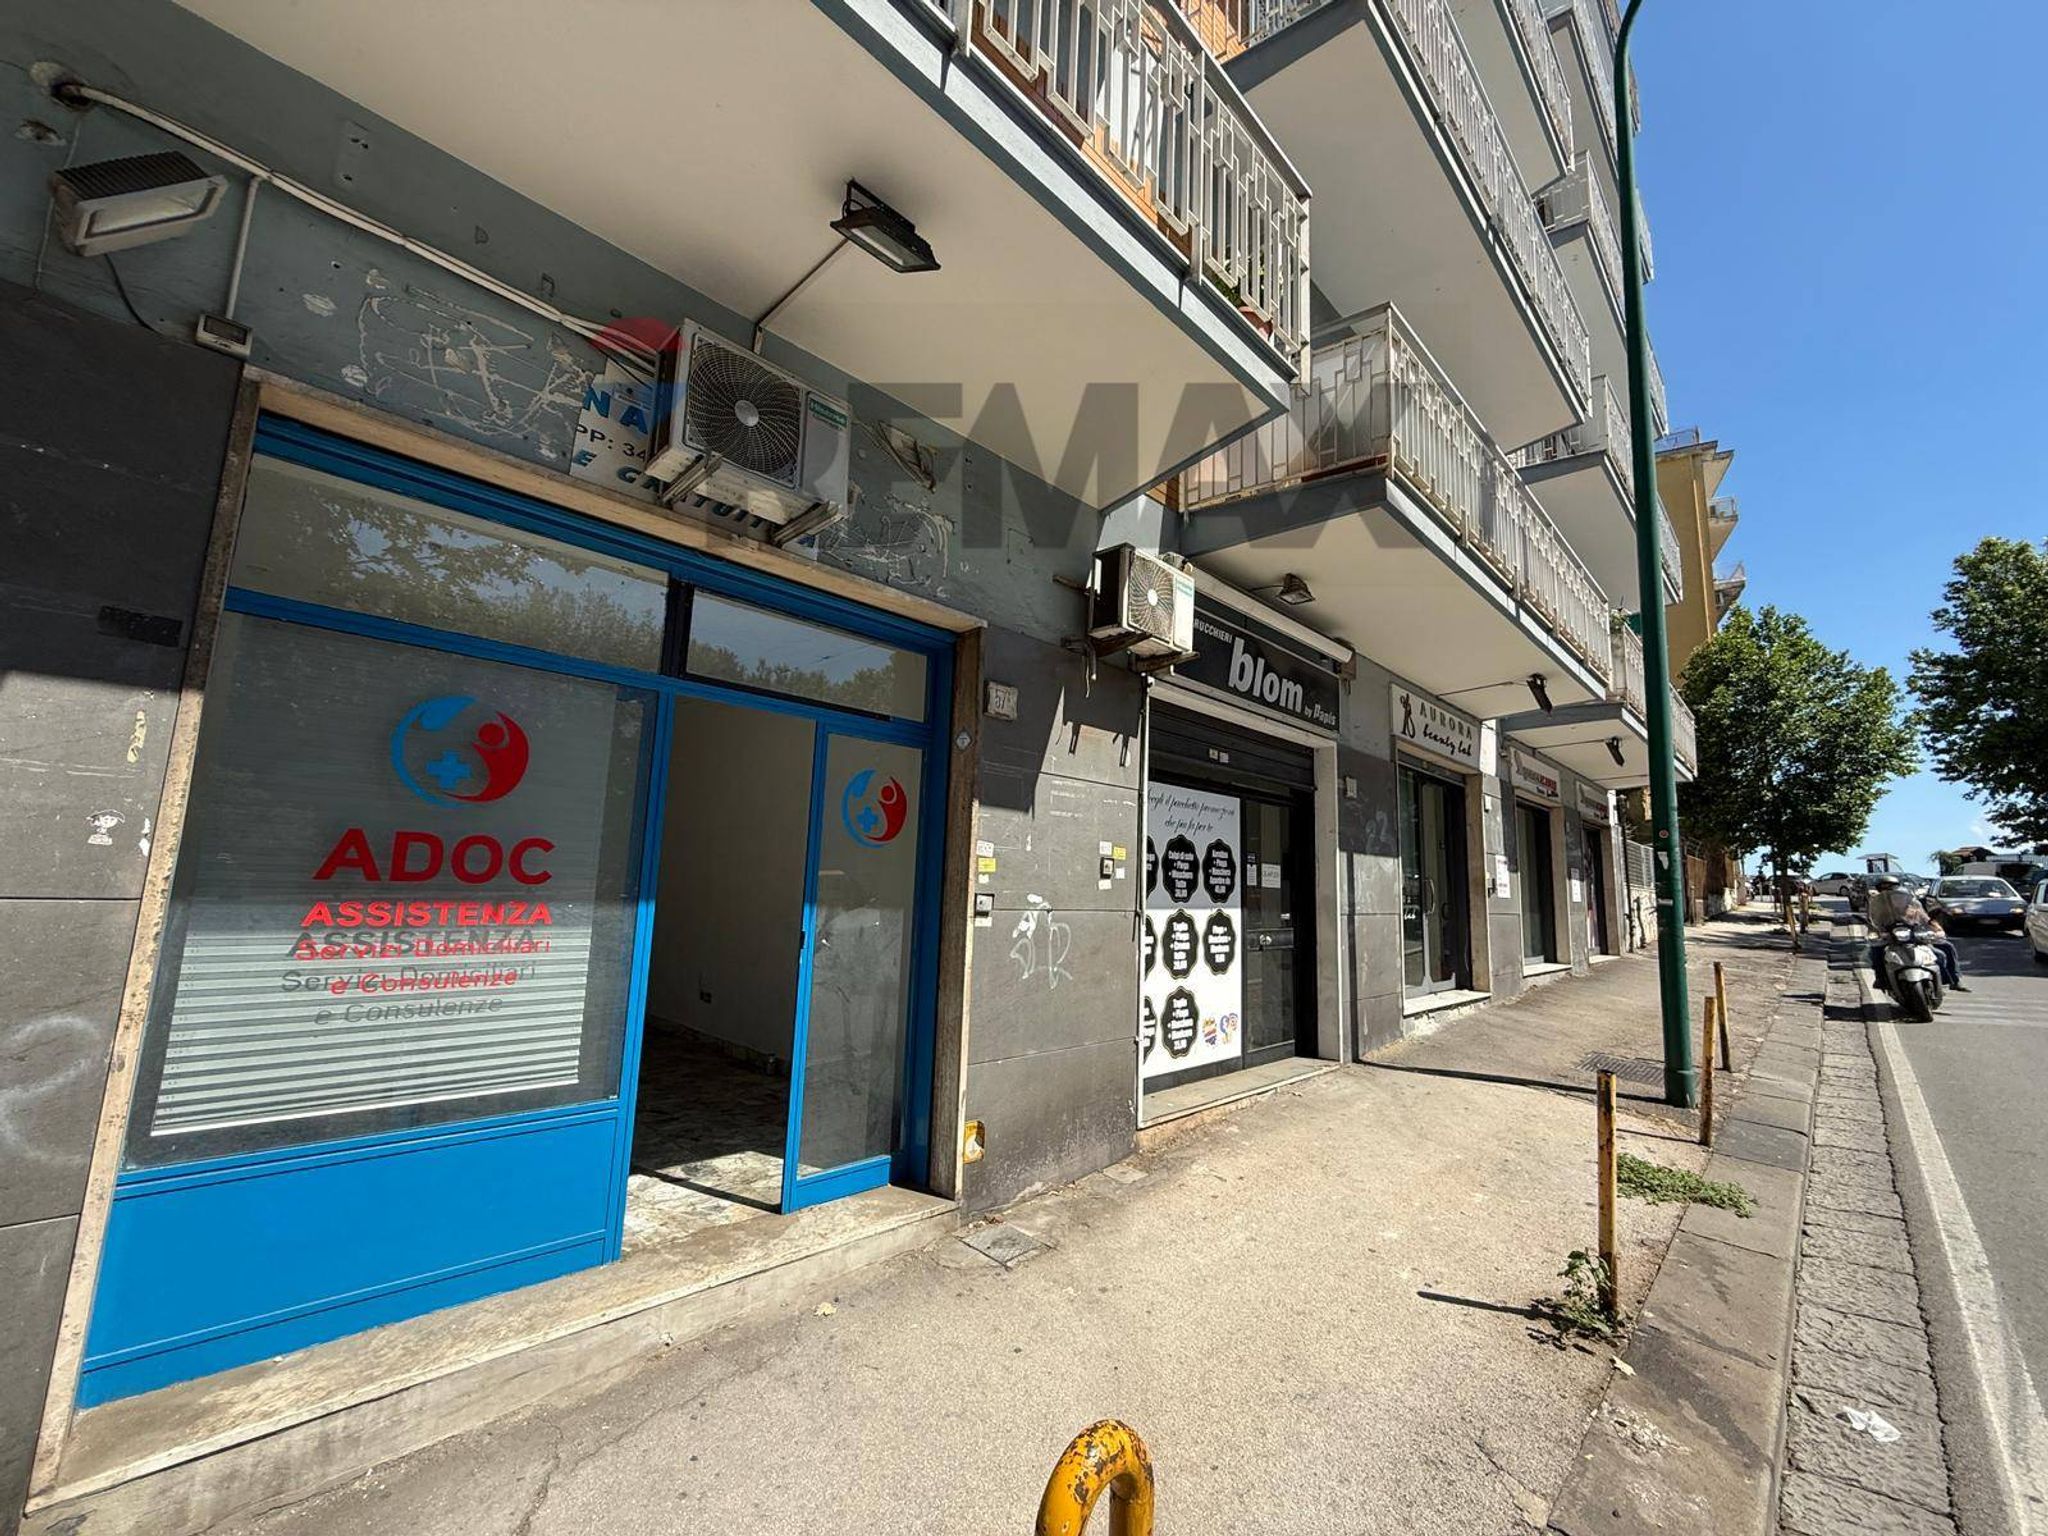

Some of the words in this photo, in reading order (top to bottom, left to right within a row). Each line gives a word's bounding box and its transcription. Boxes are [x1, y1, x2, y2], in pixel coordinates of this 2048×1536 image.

[1228, 637, 1304, 712] blom
[1419, 701, 1473, 740] AURORA
[312, 828, 555, 885] ADOC
[301, 900, 553, 927] ASSISTENZA
[294, 939, 403, 961] Servizi
[412, 937, 552, 957] Domiciliari
[330, 979, 348, 995] e
[359, 970, 518, 994] Consulenze
